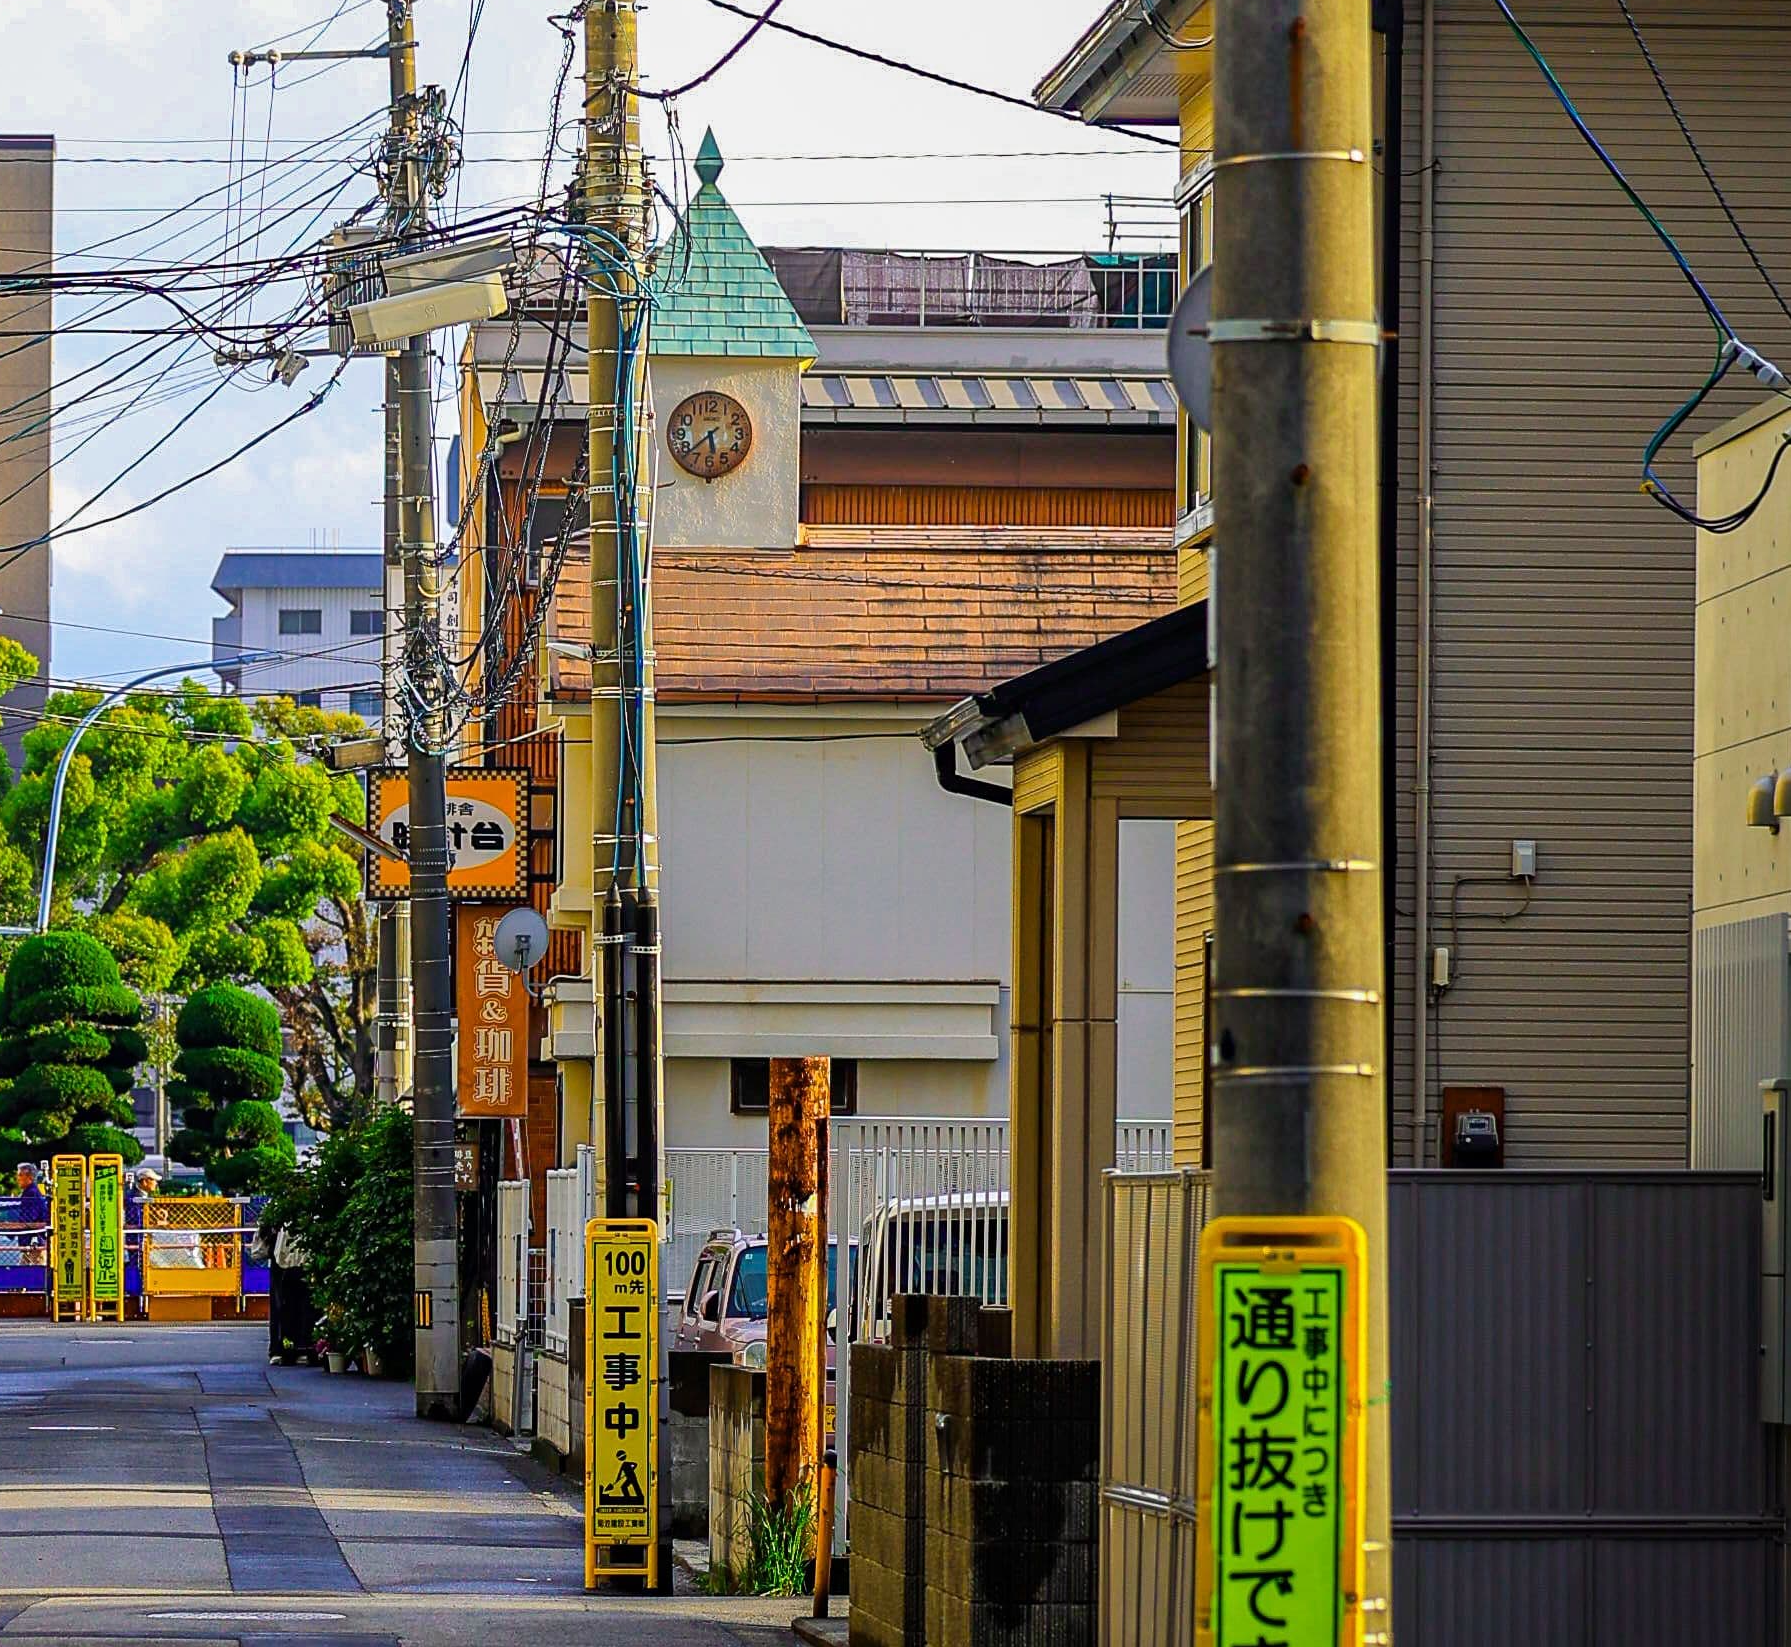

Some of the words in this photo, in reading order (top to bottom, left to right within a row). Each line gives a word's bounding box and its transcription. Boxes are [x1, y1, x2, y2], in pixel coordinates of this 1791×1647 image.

[605, 1250, 646, 1276] 100
[614, 1279, 646, 1294] m先
[602, 1305, 643, 1440] 工事中
[1302, 1287, 1330, 1519] 工事中につき
